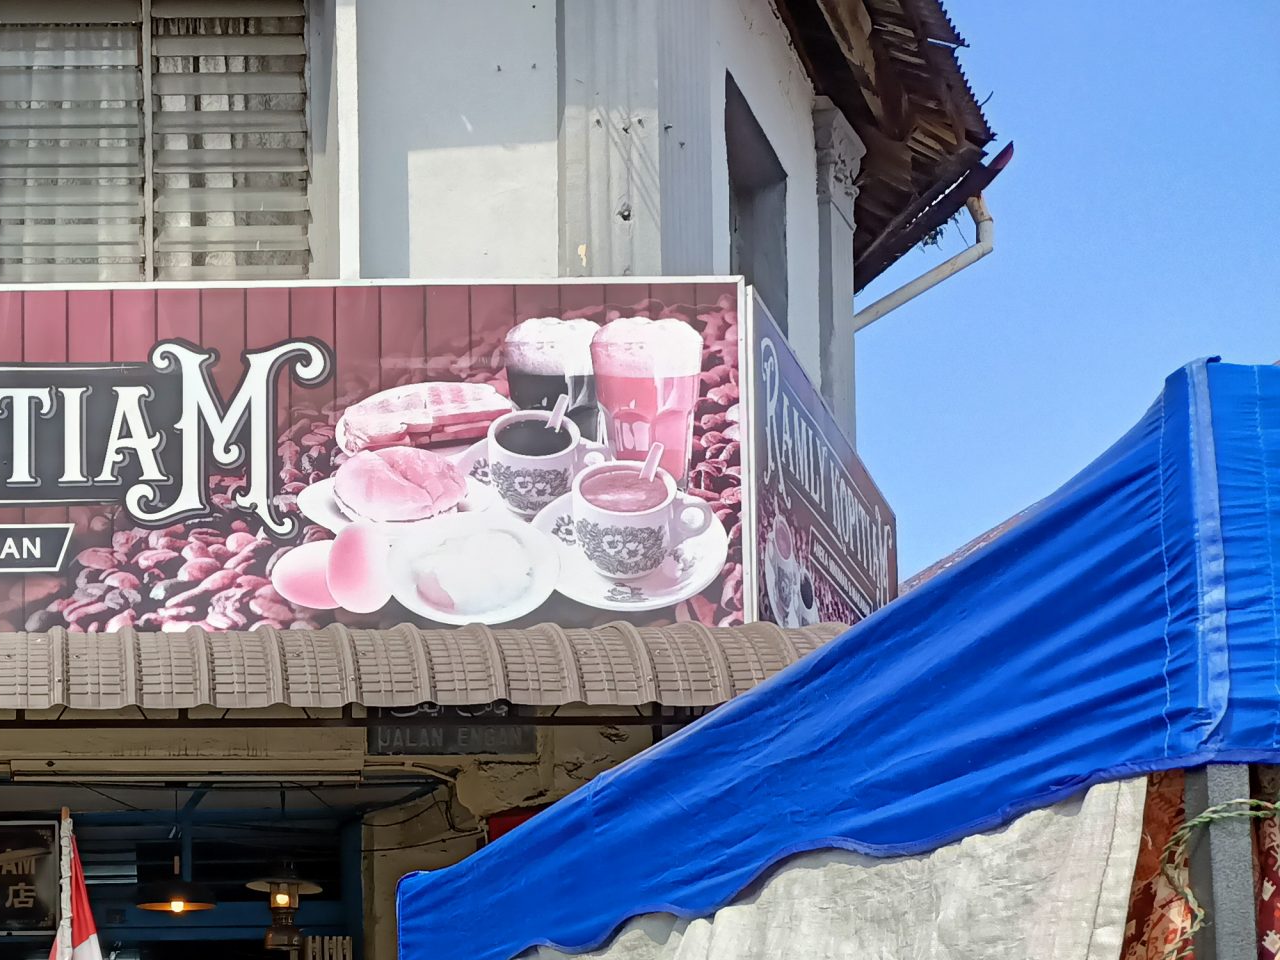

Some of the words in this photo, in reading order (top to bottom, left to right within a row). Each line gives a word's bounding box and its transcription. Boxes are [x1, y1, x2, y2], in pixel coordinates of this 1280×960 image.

[761, 337, 827, 511] RAMLY
[829, 455, 893, 607] KOPITIAM
[381, 726, 444, 747] JALAN
